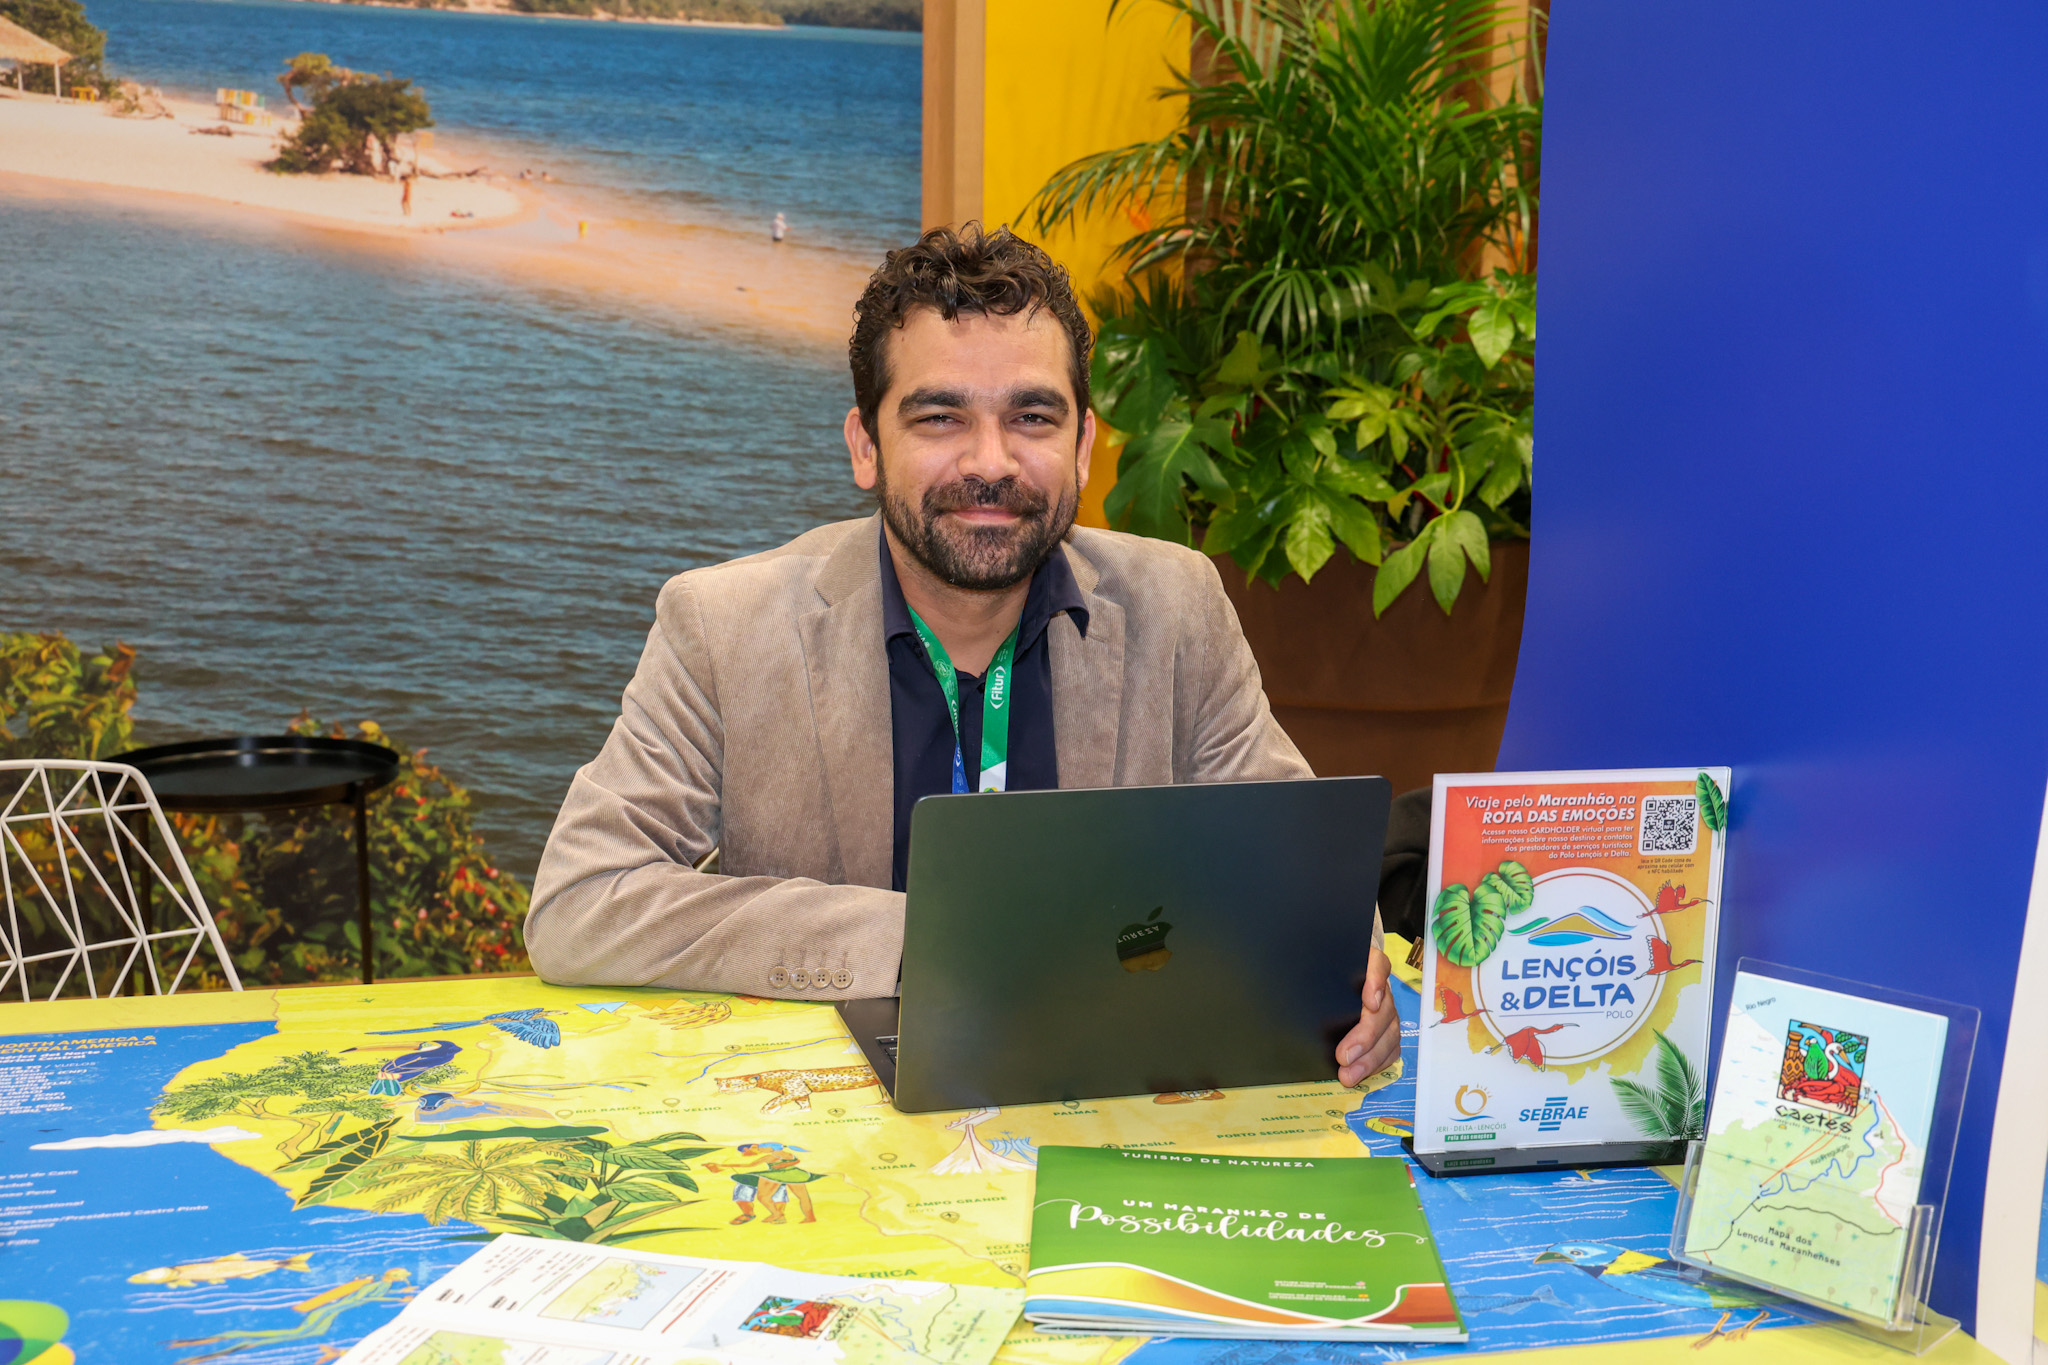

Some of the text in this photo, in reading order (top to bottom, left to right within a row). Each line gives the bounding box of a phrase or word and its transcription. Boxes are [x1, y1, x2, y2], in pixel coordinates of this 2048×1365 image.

[1465, 792, 1636, 811] Viaje pelo Maranhão na
[1482, 805, 1635, 824] ROTA DAS EMOÇÕES
[1530, 826, 1580, 834] CARDHOLDER
[1582, 825, 1604, 833] virtual
[1606, 826, 1622, 834] para
[1481, 836, 1525, 845] informações
[1526, 835, 1546, 843] sobre
[1570, 834, 1595, 842] destino
[1505, 844, 1517, 852] dos
[1519, 843, 1560, 853] prestadores
[1562, 842, 1571, 850] de
[1573, 842, 1600, 851] serviços
[1560, 851, 1575, 859] Polo
[1576, 850, 1602, 860] Lençóis
[1501, 949, 1636, 982] LENÇÓIS
[1606, 1010, 1633, 1019] POLO
[58, 1036, 139, 1046] AMERICA
[76, 1040, 157, 1050] AMERICA
[1277, 1091, 1333, 1099] SALVADOR
[1518, 1107, 1588, 1123] SEBRAE
[1477, 1122, 1507, 1131] LENÇÓIS
[1122, 1152, 1315, 1168] TURISMO DE NATUREZA
[1123, 1199, 1326, 1220] UM MARANHÃO DE
[1069, 1202, 1386, 1248] Possibilidades
[1768, 1227, 1812, 1246] Mapa dos
[1737, 1228, 1840, 1267] Lençóis Maranhenses
